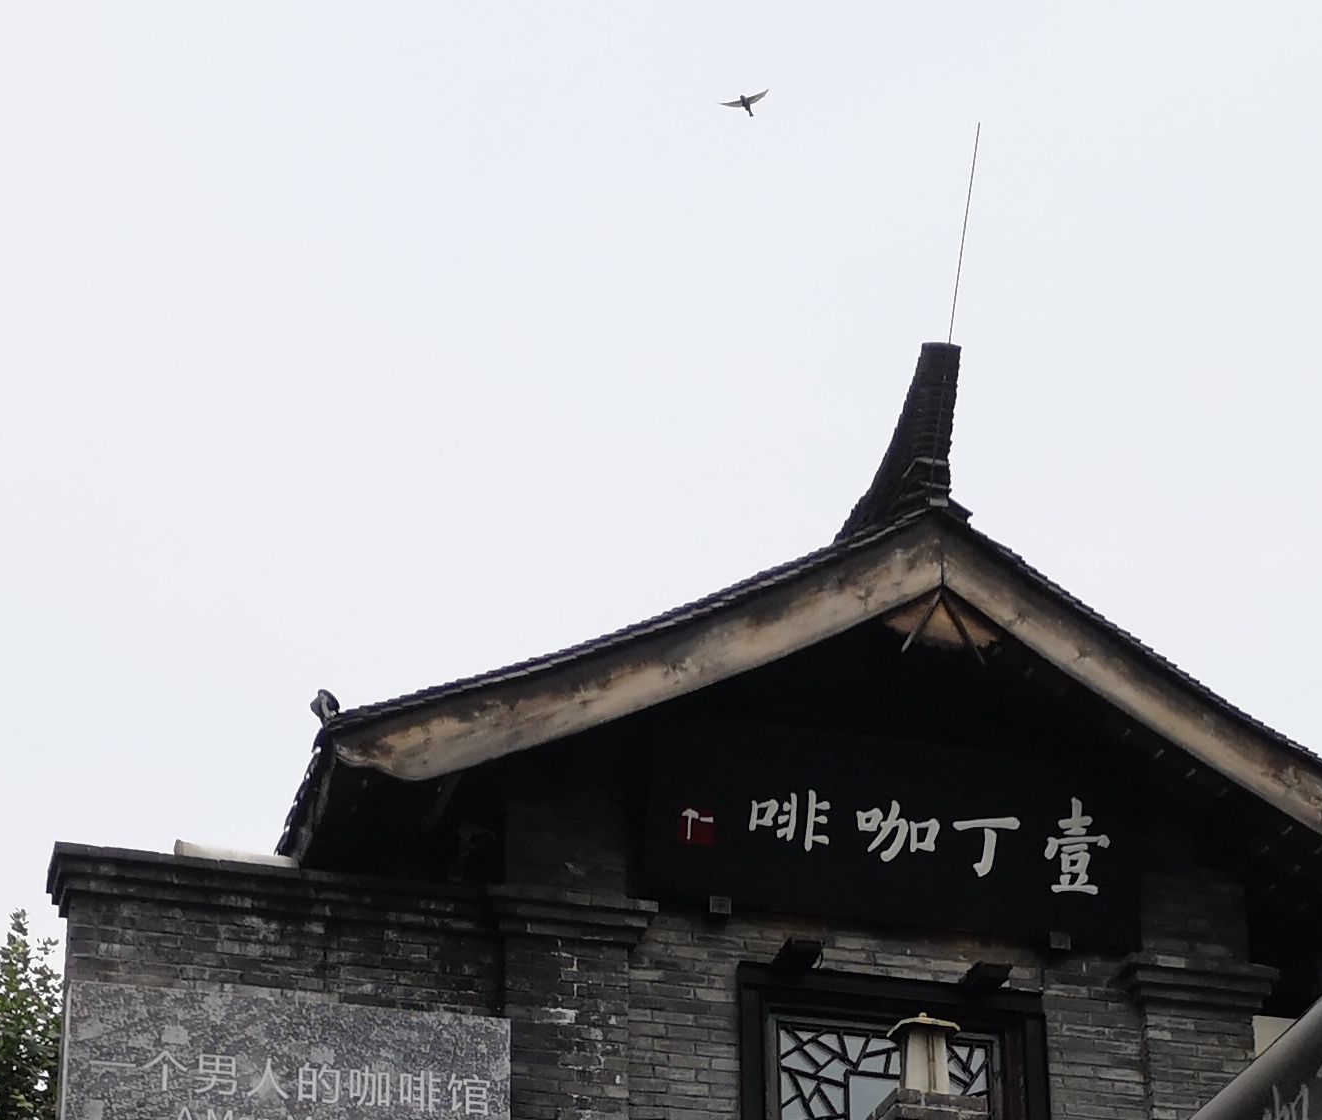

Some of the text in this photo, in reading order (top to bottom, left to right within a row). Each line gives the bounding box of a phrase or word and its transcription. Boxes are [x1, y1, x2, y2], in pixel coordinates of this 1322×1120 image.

[89, 1049, 492, 1117] 一个男人的咖啡馆
